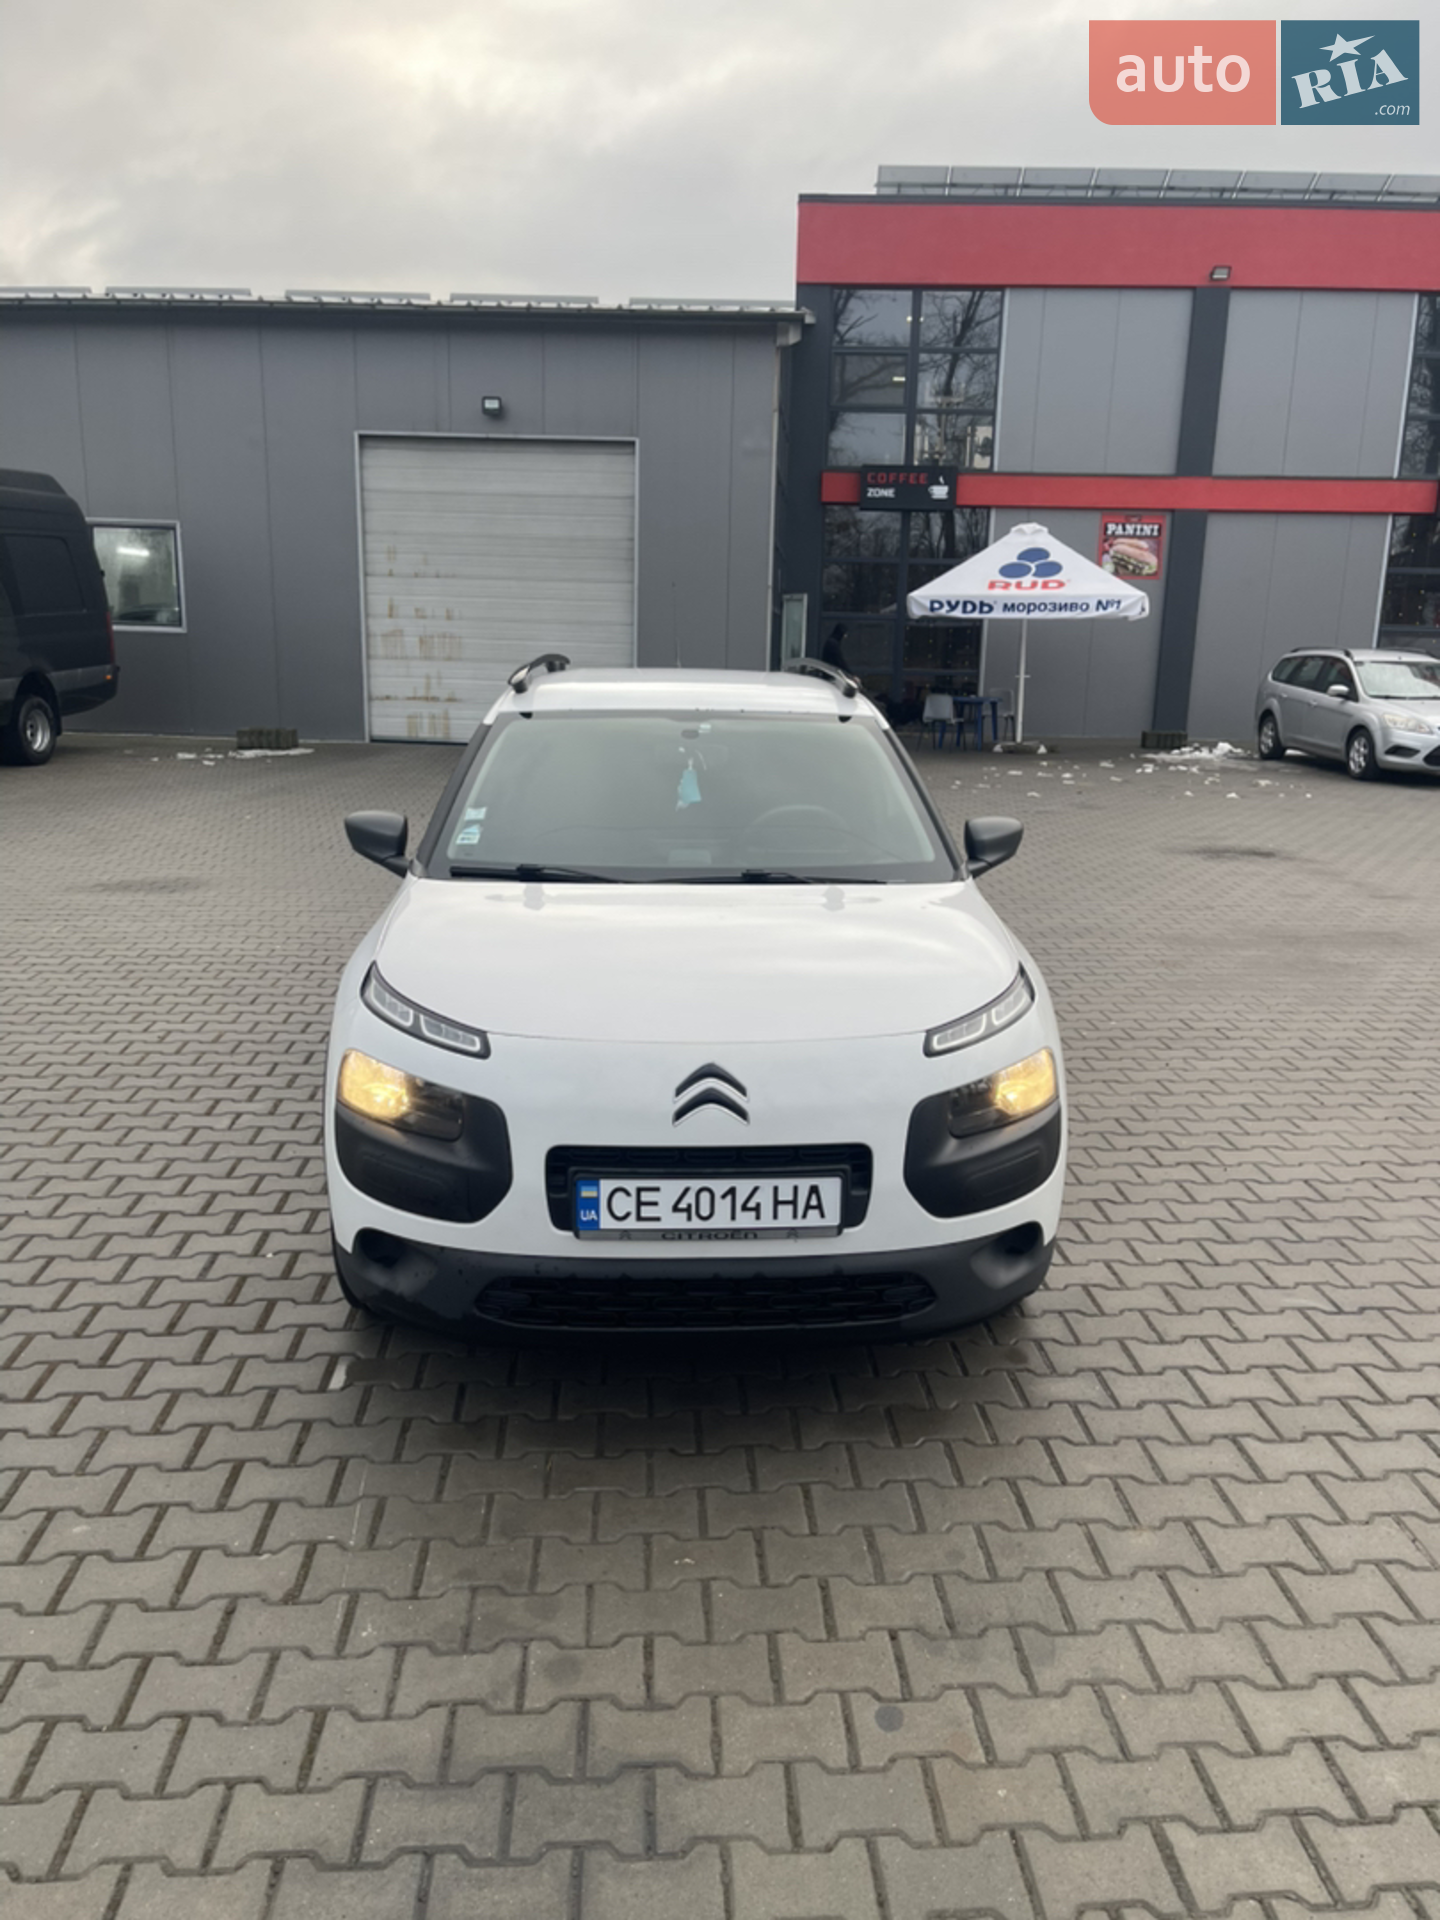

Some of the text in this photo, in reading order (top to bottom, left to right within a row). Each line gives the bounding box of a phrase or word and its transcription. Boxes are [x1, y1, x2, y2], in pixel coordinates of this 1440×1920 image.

[867, 472, 928, 484] COFFEE
[866, 487, 895, 498] ZONE
[1106, 523, 1160, 537] PANINI
[987, 579, 1066, 591] RUD
[1002, 602, 1090, 615] морозиво
[672, 1185, 761, 1222] 4014
[580, 1210, 598, 1221] UA
